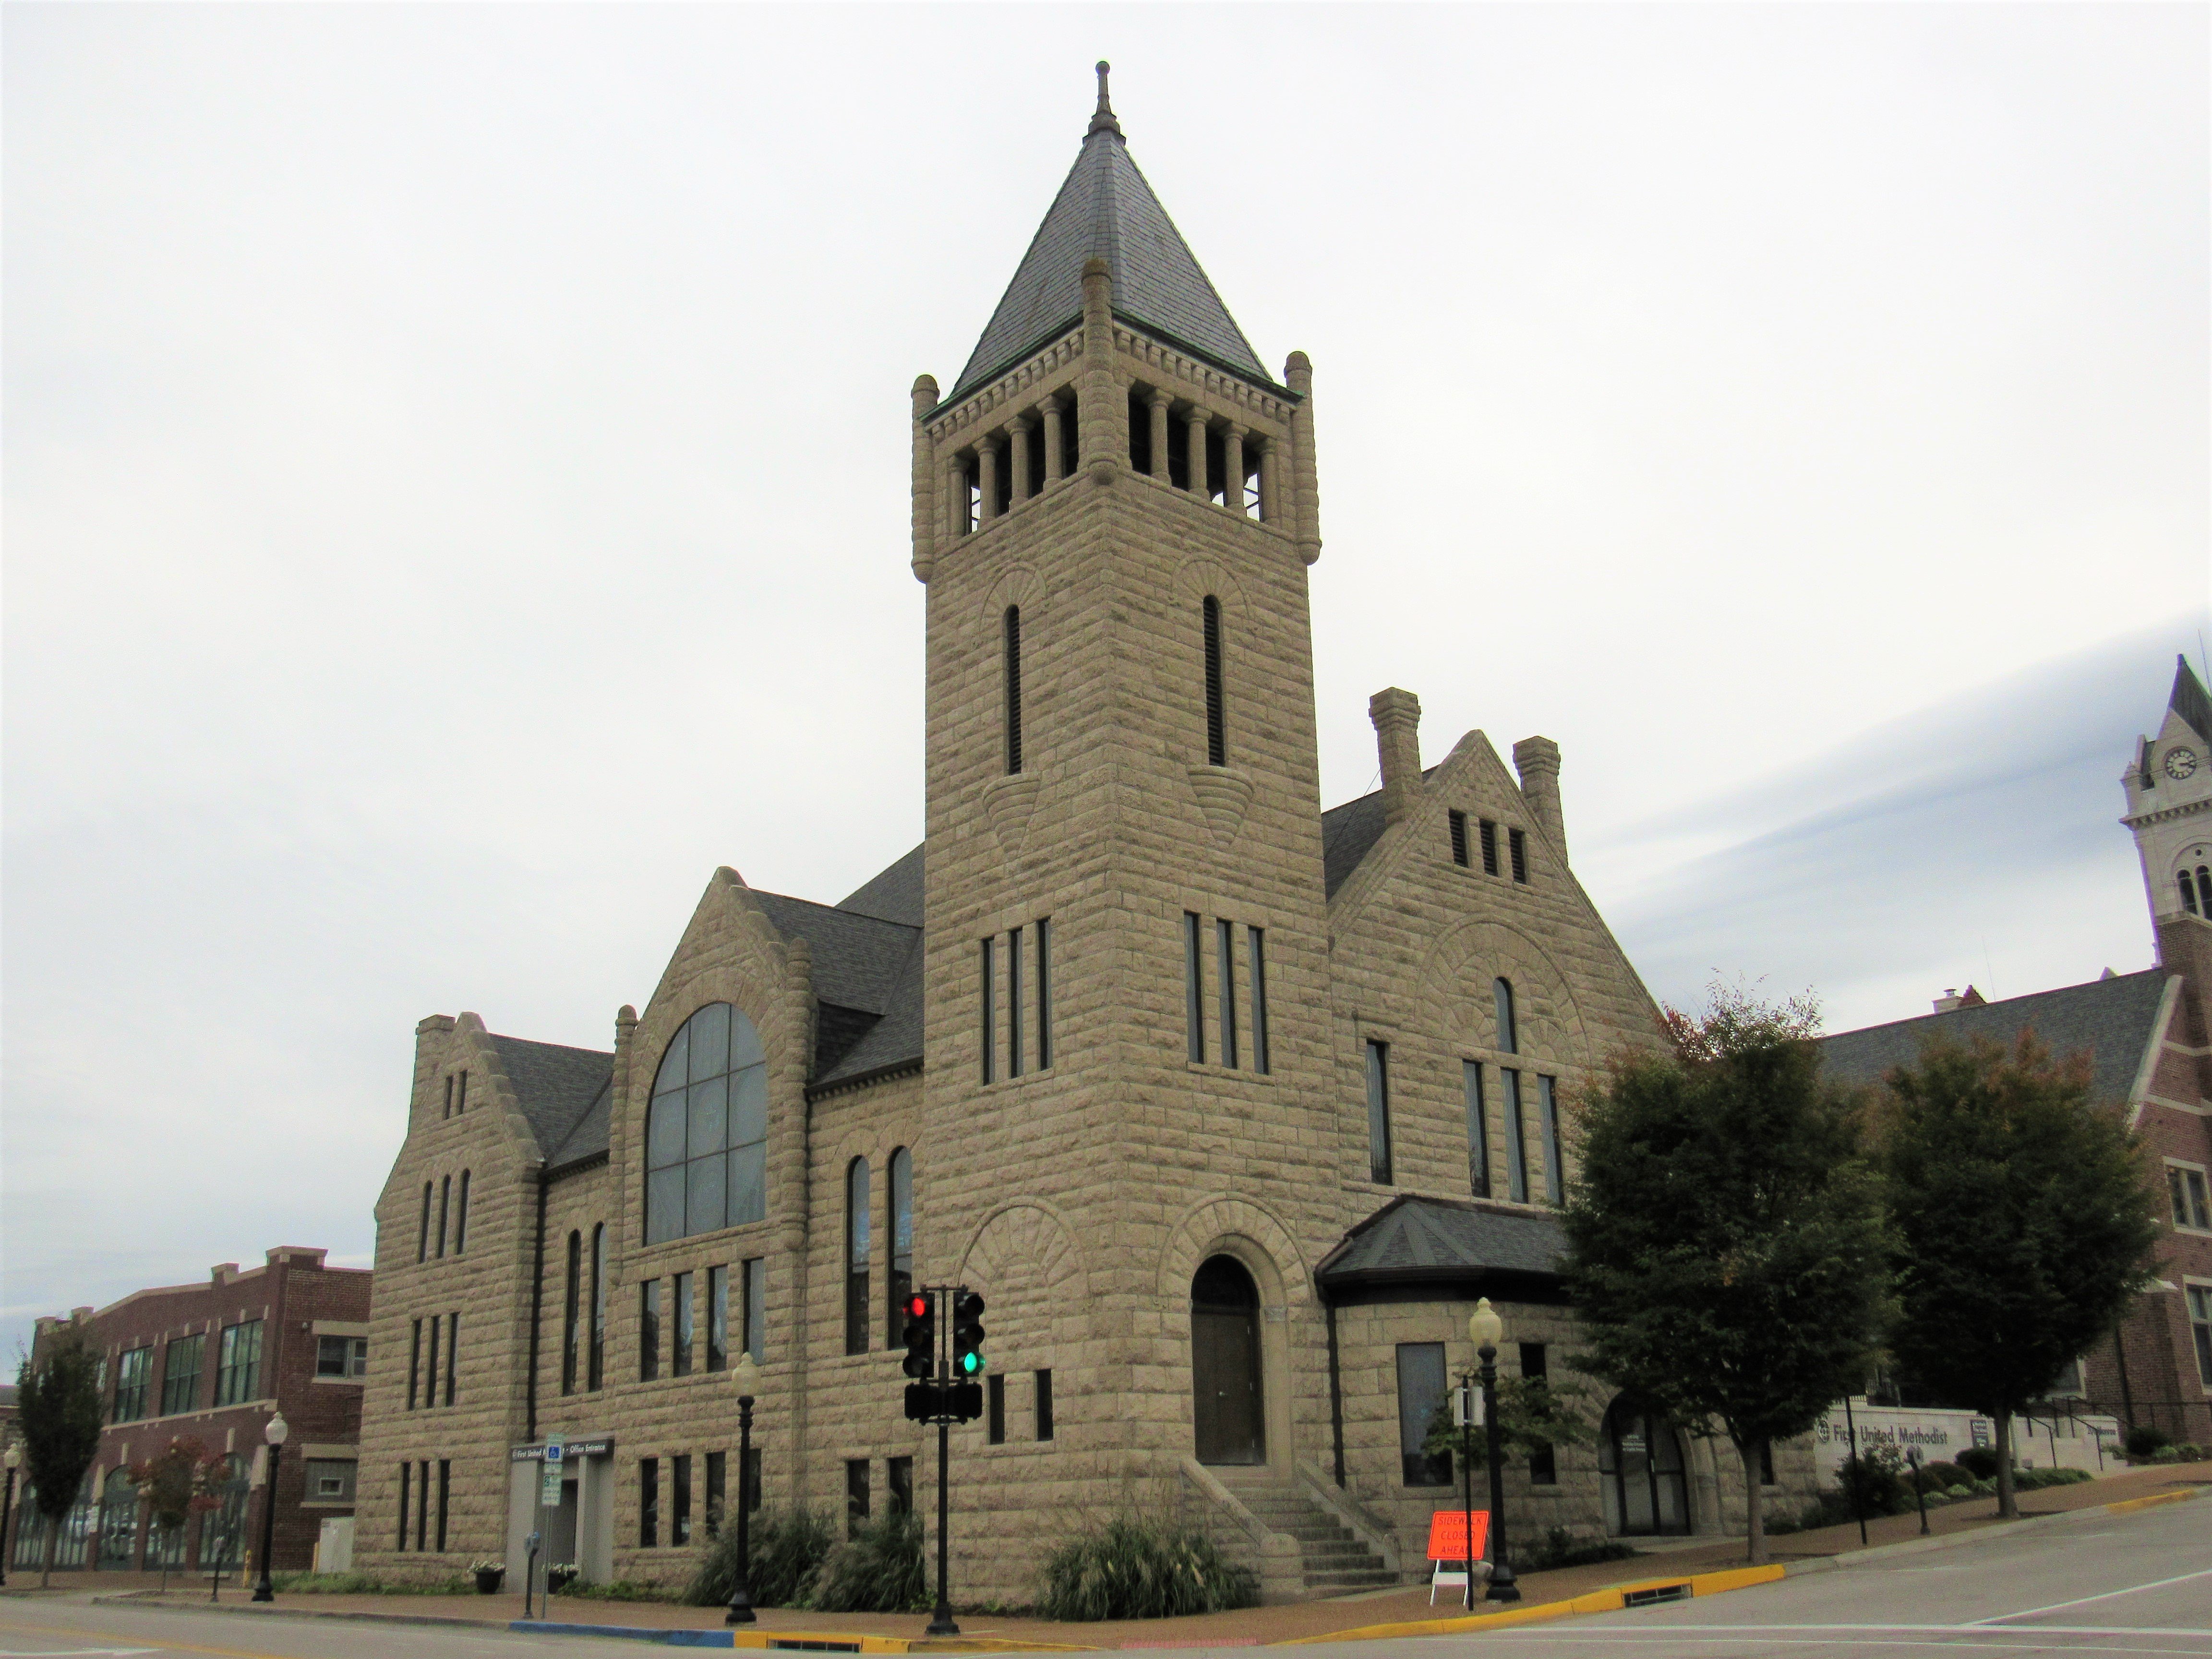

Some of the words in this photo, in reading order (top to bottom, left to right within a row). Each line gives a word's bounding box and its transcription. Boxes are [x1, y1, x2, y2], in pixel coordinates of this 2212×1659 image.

[1861, 1425, 1894, 1443] United
[1899, 1426, 1948, 1445] Methodist
[1439, 1516, 1482, 1525] SIDEWLK
[1442, 1546, 1472, 1554] AHEA
